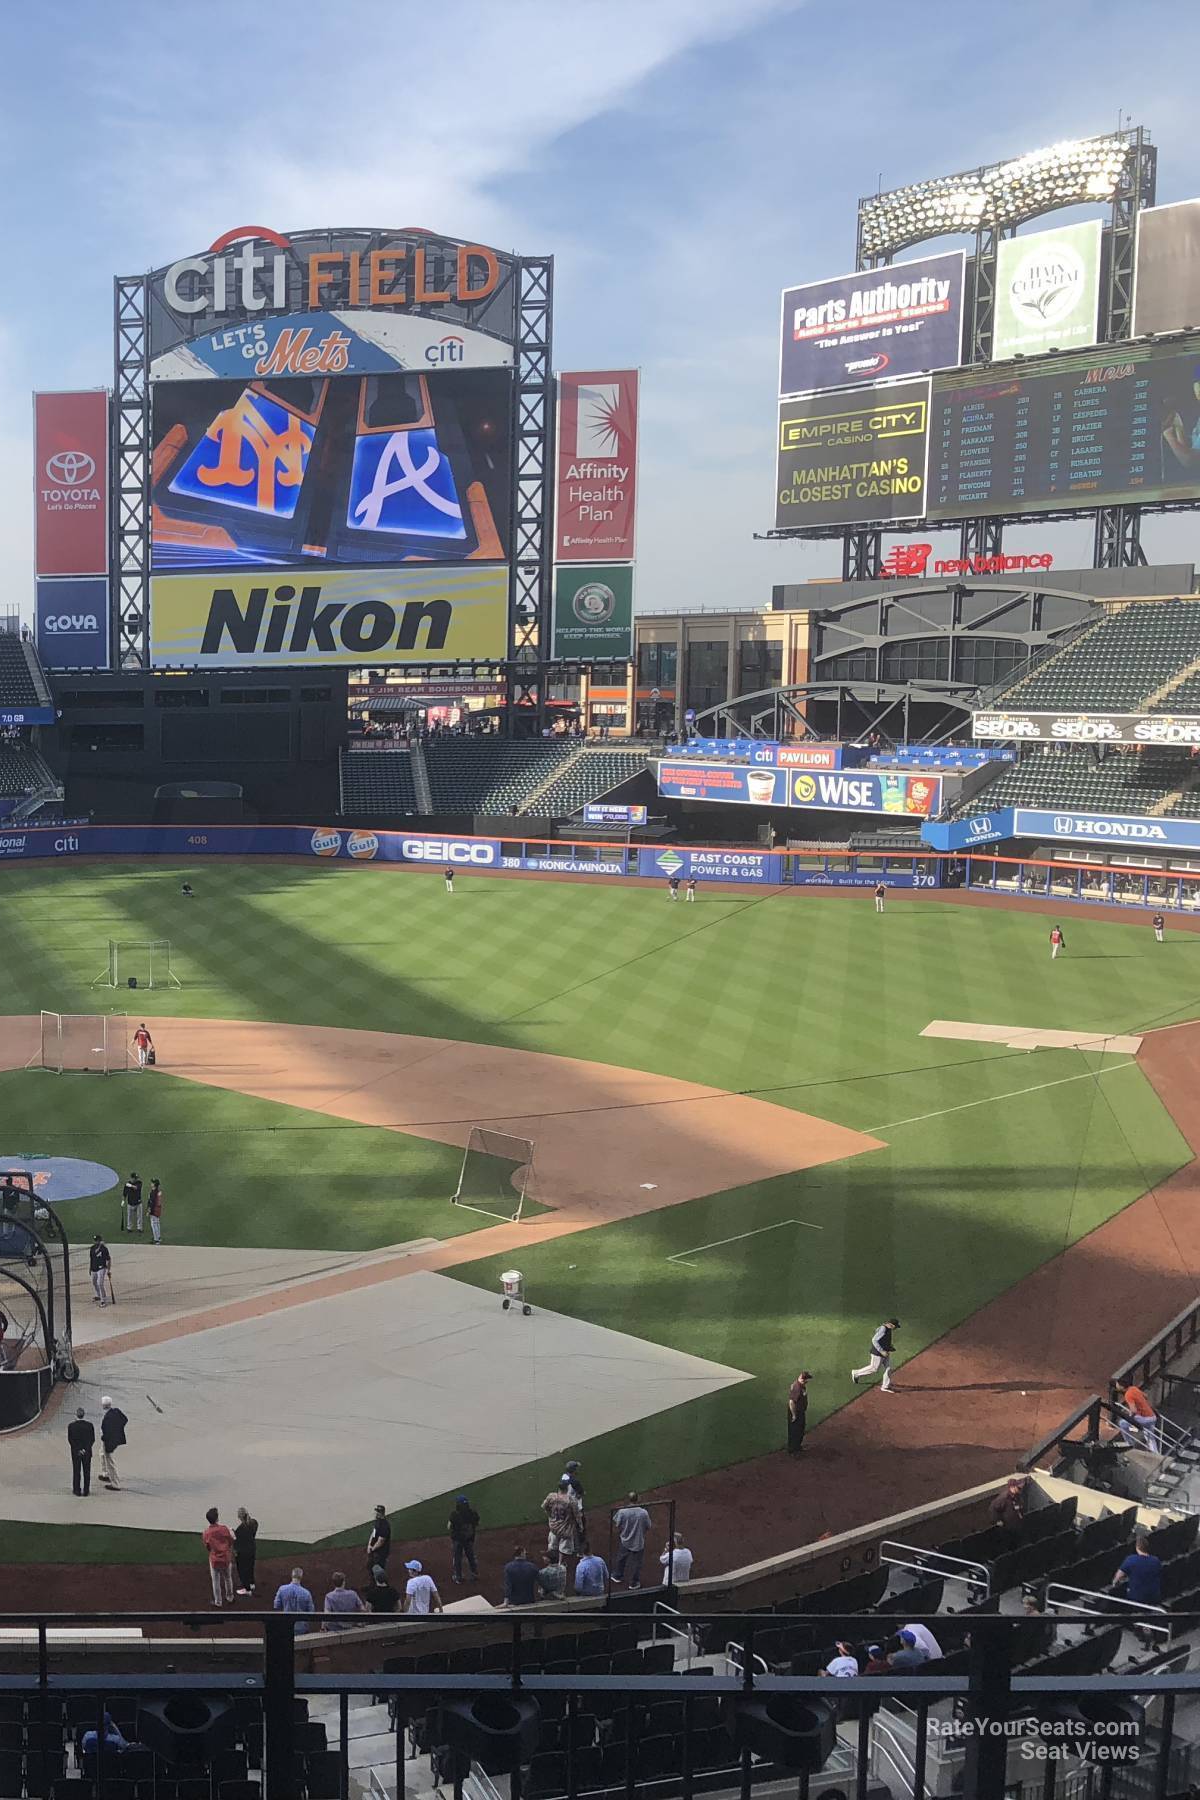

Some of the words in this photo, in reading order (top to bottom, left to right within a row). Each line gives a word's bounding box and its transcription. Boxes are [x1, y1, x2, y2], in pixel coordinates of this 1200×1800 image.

[164, 241, 286, 313] citi
[309, 246, 498, 307] FIELD
[794, 299, 847, 331] Parts
[849, 277, 950, 320] Authority
[211, 324, 267, 352] LET'S
[840, 329, 880, 345] Answer
[242, 338, 269, 359] GO
[255, 328, 351, 375] Mets
[424, 339, 464, 363] citi
[1073, 386, 1107, 397] CABRERA
[1073, 399, 1100, 408] FLORES
[788, 419, 863, 441] EMPIRE
[868, 412, 917, 431] CITY.
[961, 424, 992, 434] FREEMAN
[1072, 422, 1103, 432] FRAZIER
[827, 433, 873, 447] CASINO
[1071, 434, 1095, 443] BRUCE
[960, 447, 990, 457] FLOWERS
[1071, 445, 1103, 455] LAGARES
[960, 458, 992, 468] SWANSON
[1070, 458, 1101, 467] ROSARIO
[566, 463, 629, 482] Affinity
[792, 457, 909, 486] MANHATTAN'S
[959, 469, 993, 479] FLAHERTY
[1069, 470, 1102, 480] LOBATON
[779, 483, 852, 505] CLOSEST
[855, 475, 922, 498] CASINO
[958, 481, 991, 490] NEWCOMB
[41, 489, 101, 502] TOYOTA
[570, 486, 624, 502] Health
[47, 503, 63, 511] Let's
[64, 503, 74, 511] Go
[74, 502, 97, 510] Places
[578, 505, 613, 521] Plan
[571, 536, 593, 546] Affinity
[594, 536, 614, 544] Health
[614, 535, 628, 544] Plan
[934, 558, 970, 574] new
[973, 552, 1054, 573] balance
[45, 615, 98, 631] GOYA
[200, 584, 453, 654] Nikon
[428, 685, 474, 693] BOURBON
[2, 714, 13, 723] 7.0
[14, 714, 24, 722] GB
[755, 750, 773, 762] citi
[780, 752, 829, 765] PAVILION
[1075, 820, 1167, 839] HONDA
[54, 836, 79, 851] citi
[187, 835, 208, 845] 408
[313, 836, 340, 849] Gulf
[965, 831, 1001, 844] HONDA
[348, 838, 378, 852] Gulf
[402, 840, 494, 864] GEICO
[502, 857, 520, 868] 380
[539, 859, 580, 872] KONICA
[580, 861, 622, 873] MINOLTA
[690, 853, 728, 864] EAST
[730, 855, 763, 866] COAST
[690, 865, 730, 876] POWER
[731, 868, 738, 876] &
[740, 868, 764, 878] GAS
[912, 876, 936, 887] 370
